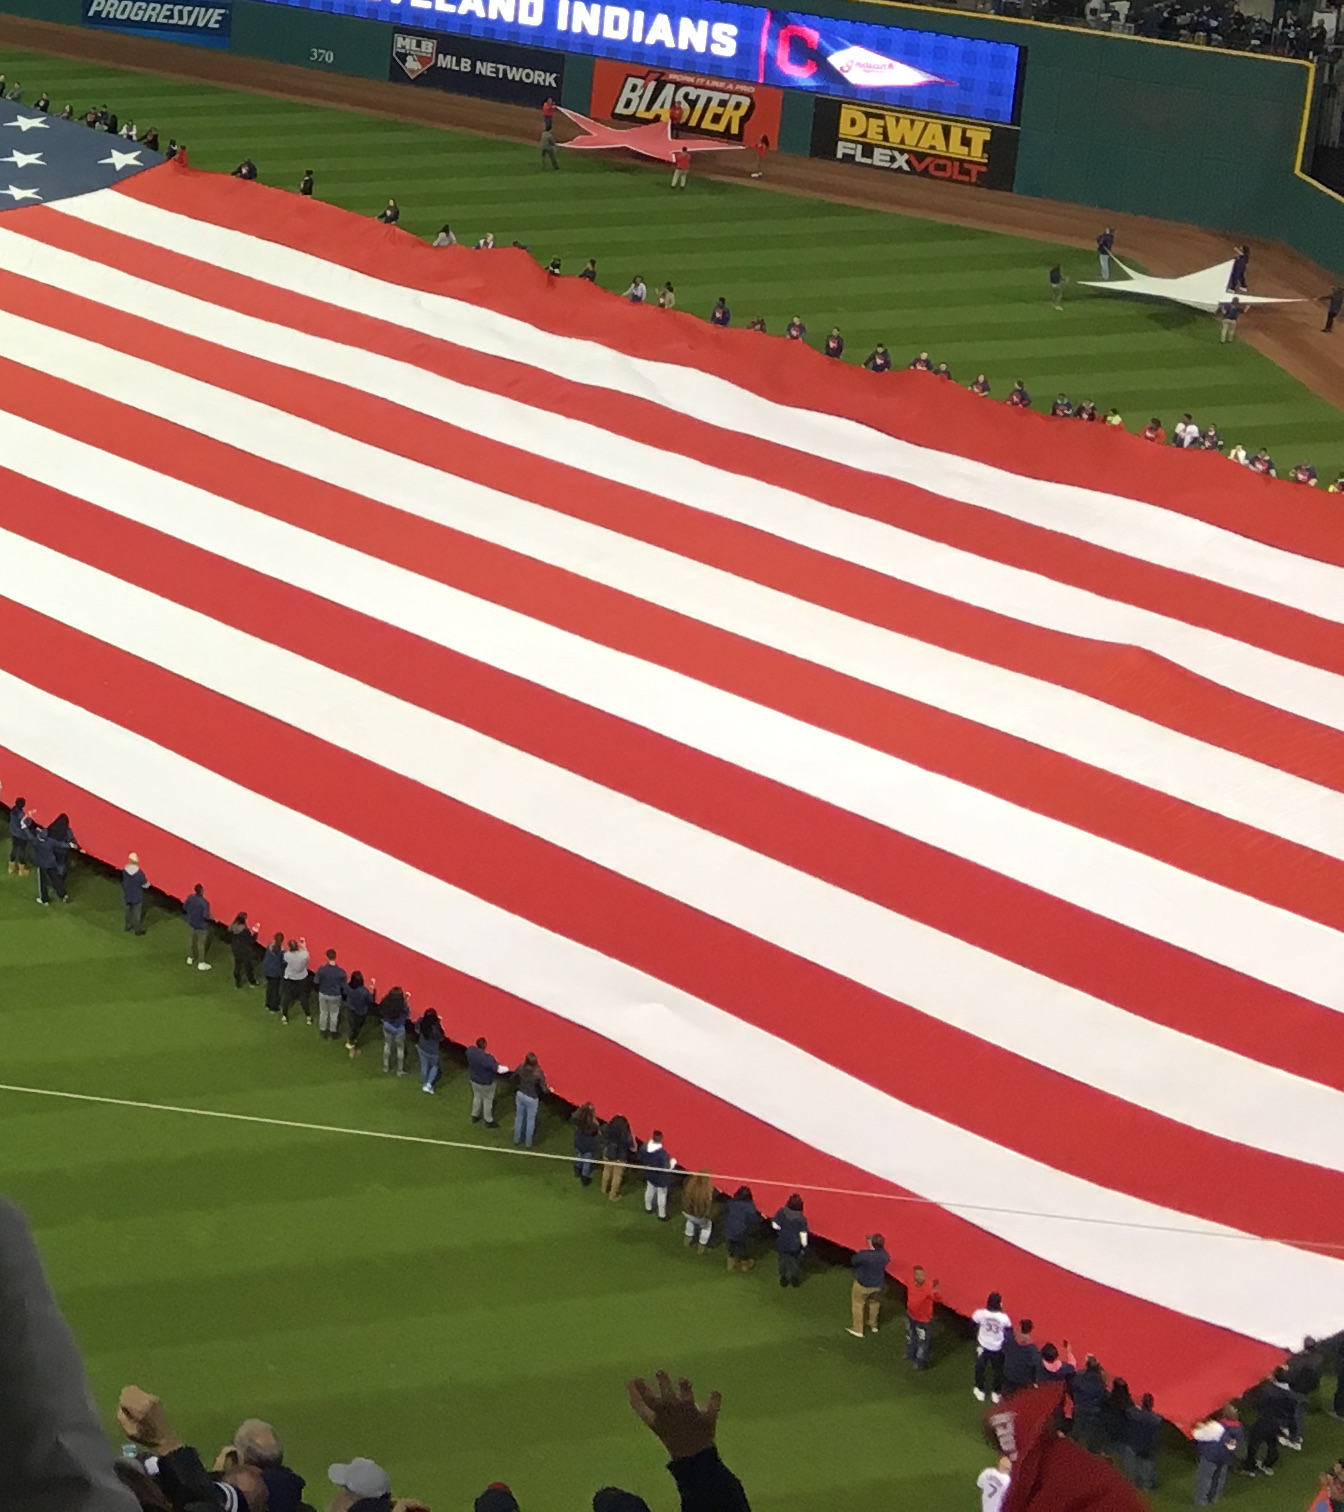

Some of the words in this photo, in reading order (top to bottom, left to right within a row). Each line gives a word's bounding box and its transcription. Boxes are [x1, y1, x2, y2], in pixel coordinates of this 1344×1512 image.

[309, 48, 334, 65] 370
[436, 53, 472, 73] MLB
[475, 59, 558, 88] NETWORK
[614, 76, 752, 135] BLASTER
